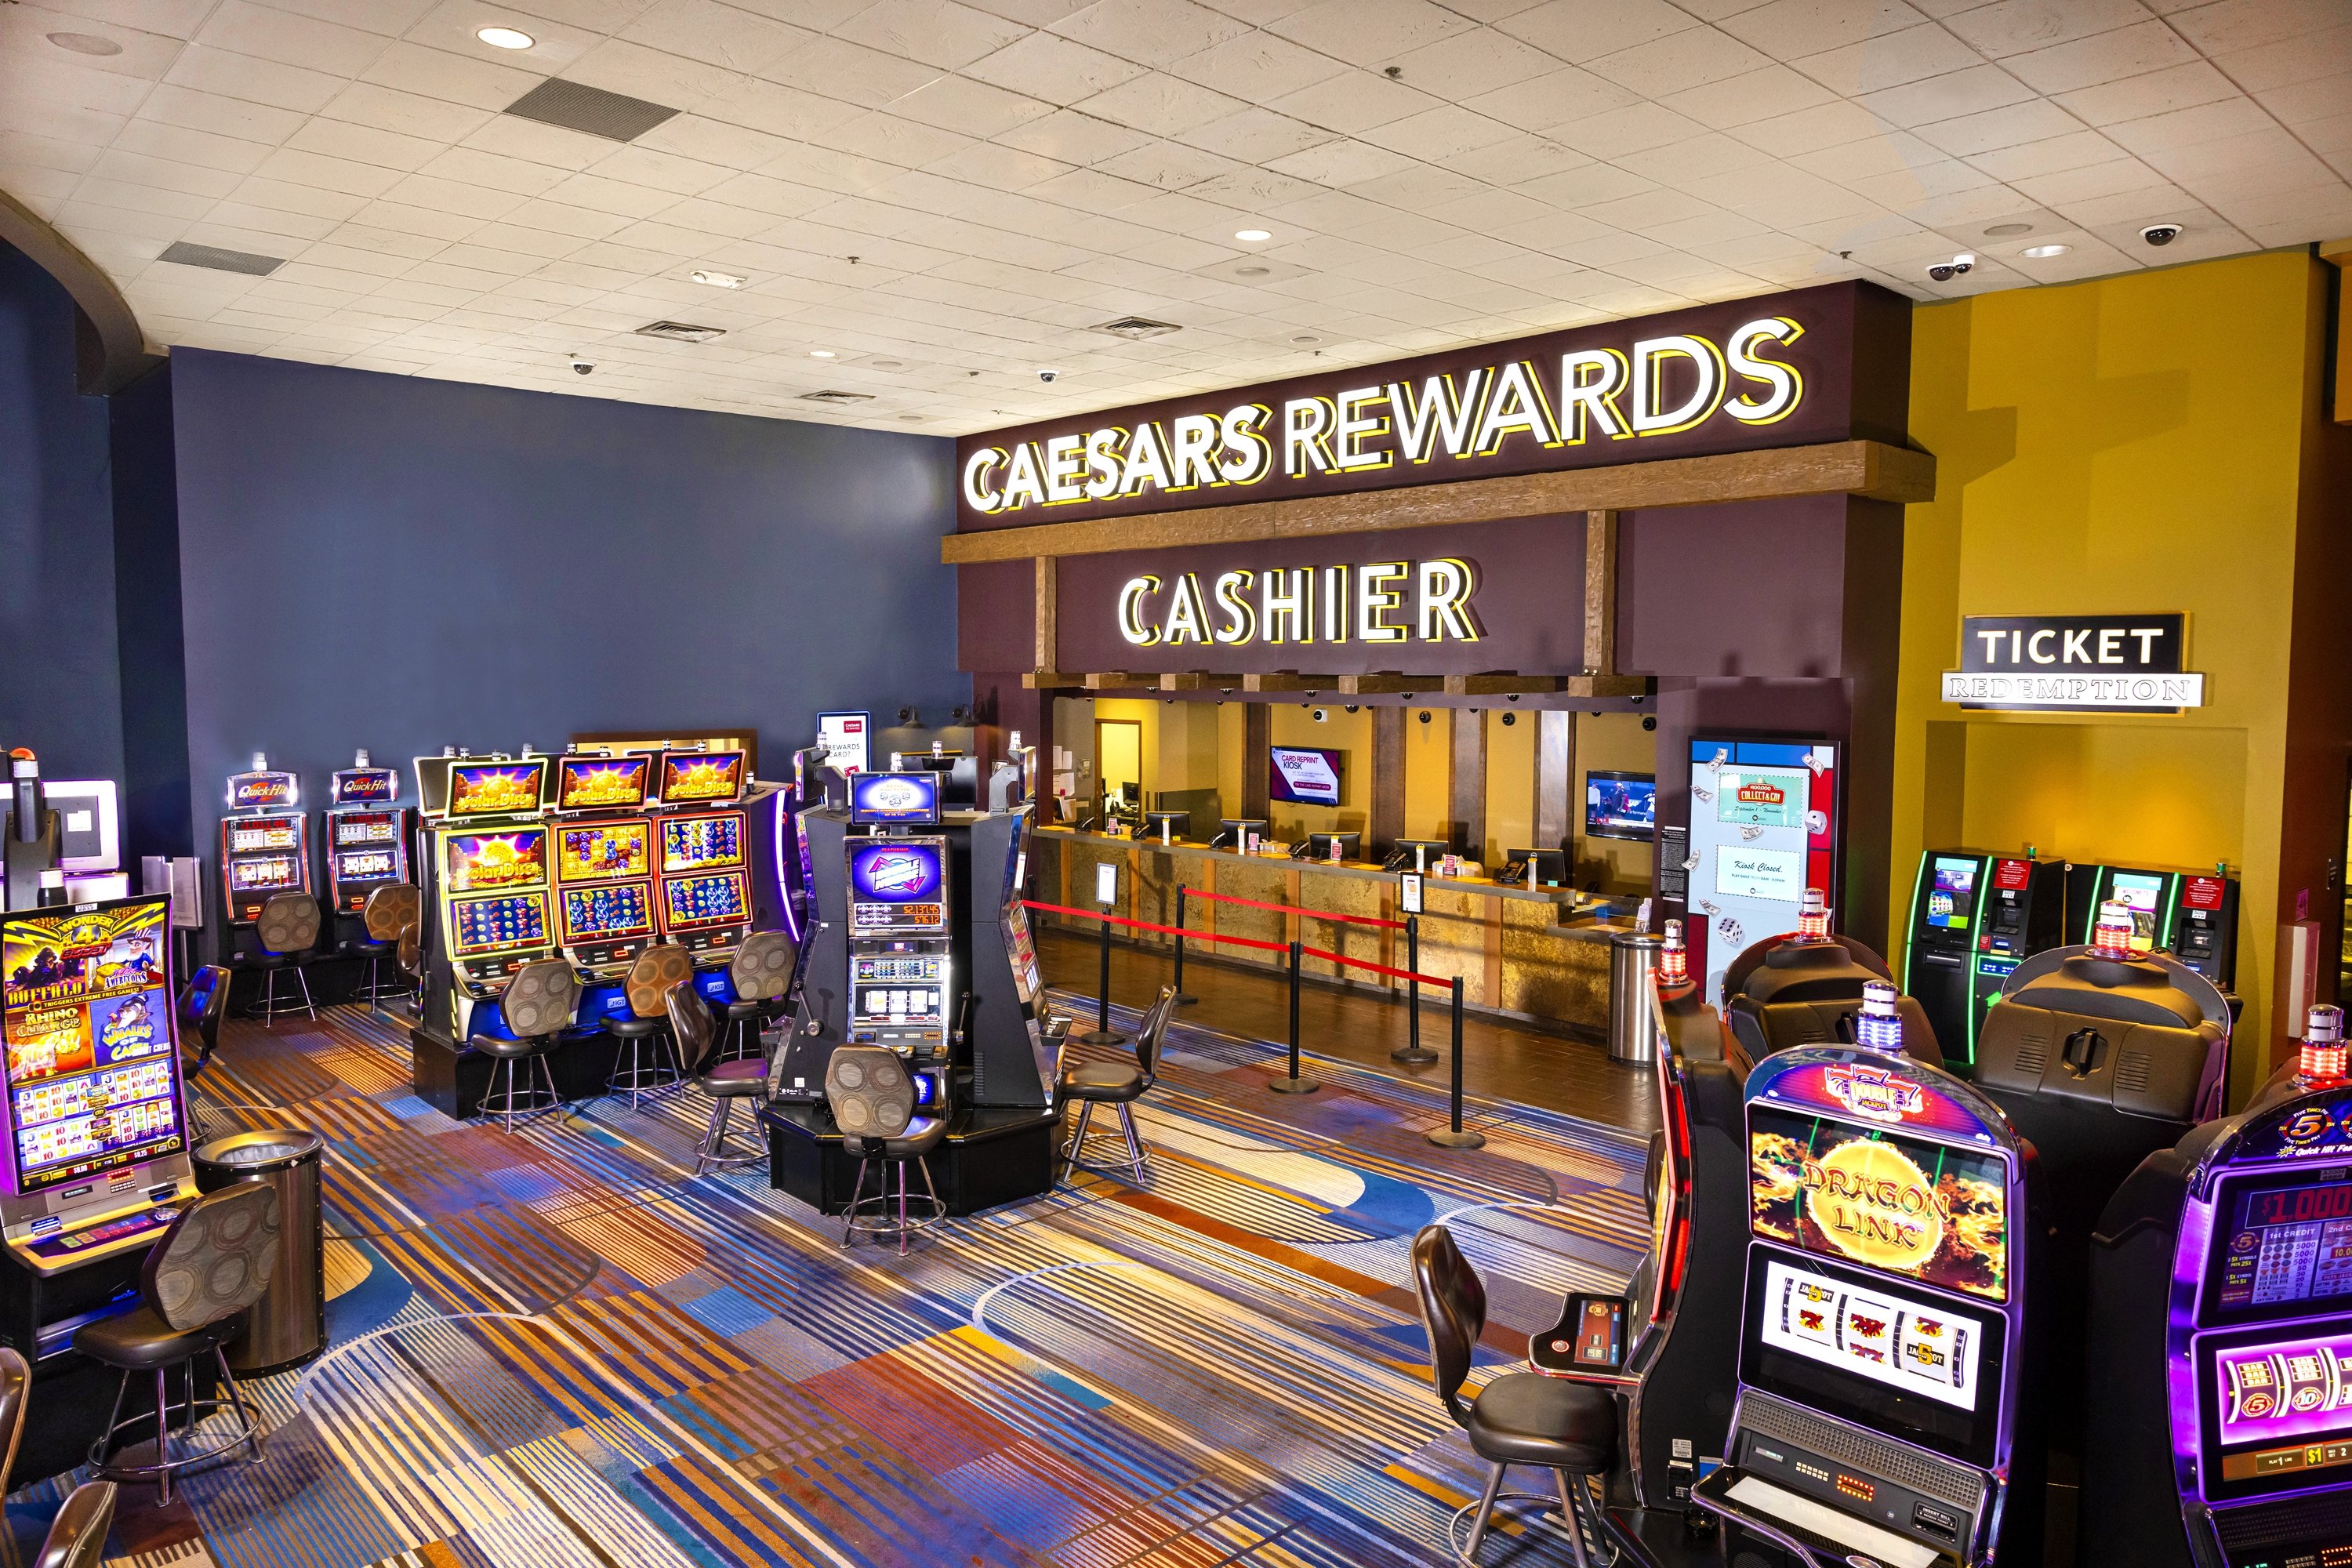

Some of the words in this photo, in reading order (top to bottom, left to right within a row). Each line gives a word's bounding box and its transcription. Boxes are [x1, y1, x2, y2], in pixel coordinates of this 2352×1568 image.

[964, 403, 1272, 514] CAESARS
[1284, 317, 1805, 479] REWARDS
[1119, 559, 1480, 645] CASHIER
[1977, 629, 2164, 664] TICKET
[1950, 678, 2190, 701] REDEMPTION
[1283, 761, 1302, 770] KIOSK
[238, 785, 270, 799] Quick
[269, 782, 288, 796] Hit
[343, 780, 372, 793] Quick
[373, 779, 387, 791] Hit
[673, 784, 702, 797] Solar
[703, 782, 727, 795] Disc
[463, 794, 498, 808] Solar
[500, 793, 526, 807] Disc
[573, 790, 603, 803] Solar
[604, 787, 632, 801] Disc
[464, 866, 499, 881] Solar
[503, 862, 534, 877] Disc
[1734, 860, 1755, 870] Kiosk
[1757, 862, 1783, 873] Closed.
[59, 916, 114, 933] WONDER
[914, 916, 939, 924] $76.12
[76, 925, 95, 944] 4
[63, 943, 111, 957] BOOST
[8, 982, 82, 1006] BUFFALO
[44, 999, 74, 1007] TRIGGERS
[74, 994, 101, 1004] EXTREME
[118, 987, 140, 996] GAMES!
[25, 1008, 78, 1025] RHINO
[16, 1018, 82, 1036] CHARGE
[103, 1025, 153, 1047] WHALES
[119, 1037, 138, 1046] OF
[131, 1069, 140, 1078] 10
[1850, 1081, 1896, 1109] DOUBLE
[1861, 1099, 1887, 1110] JACKPOT
[2290, 1115, 2322, 1135] 5
[2296, 1146, 2321, 1156] Quick
[1802, 1160, 1951, 1223] DRAGON
[1832, 1206, 1918, 1250] LINK
[2284, 1229, 2315, 1237] CREDIT
[2238, 1236, 2252, 1248] 5
[1918, 1342, 1933, 1366] 5
[2249, 1399, 2267, 1412] 5
[2299, 1393, 2317, 1406] 10
[2308, 1448, 2321, 1464] $1
[2341, 1447, 2347, 1456] 2
[2278, 1457, 2283, 1465] 1
[1922, 1508, 1940, 1516] INSERT
